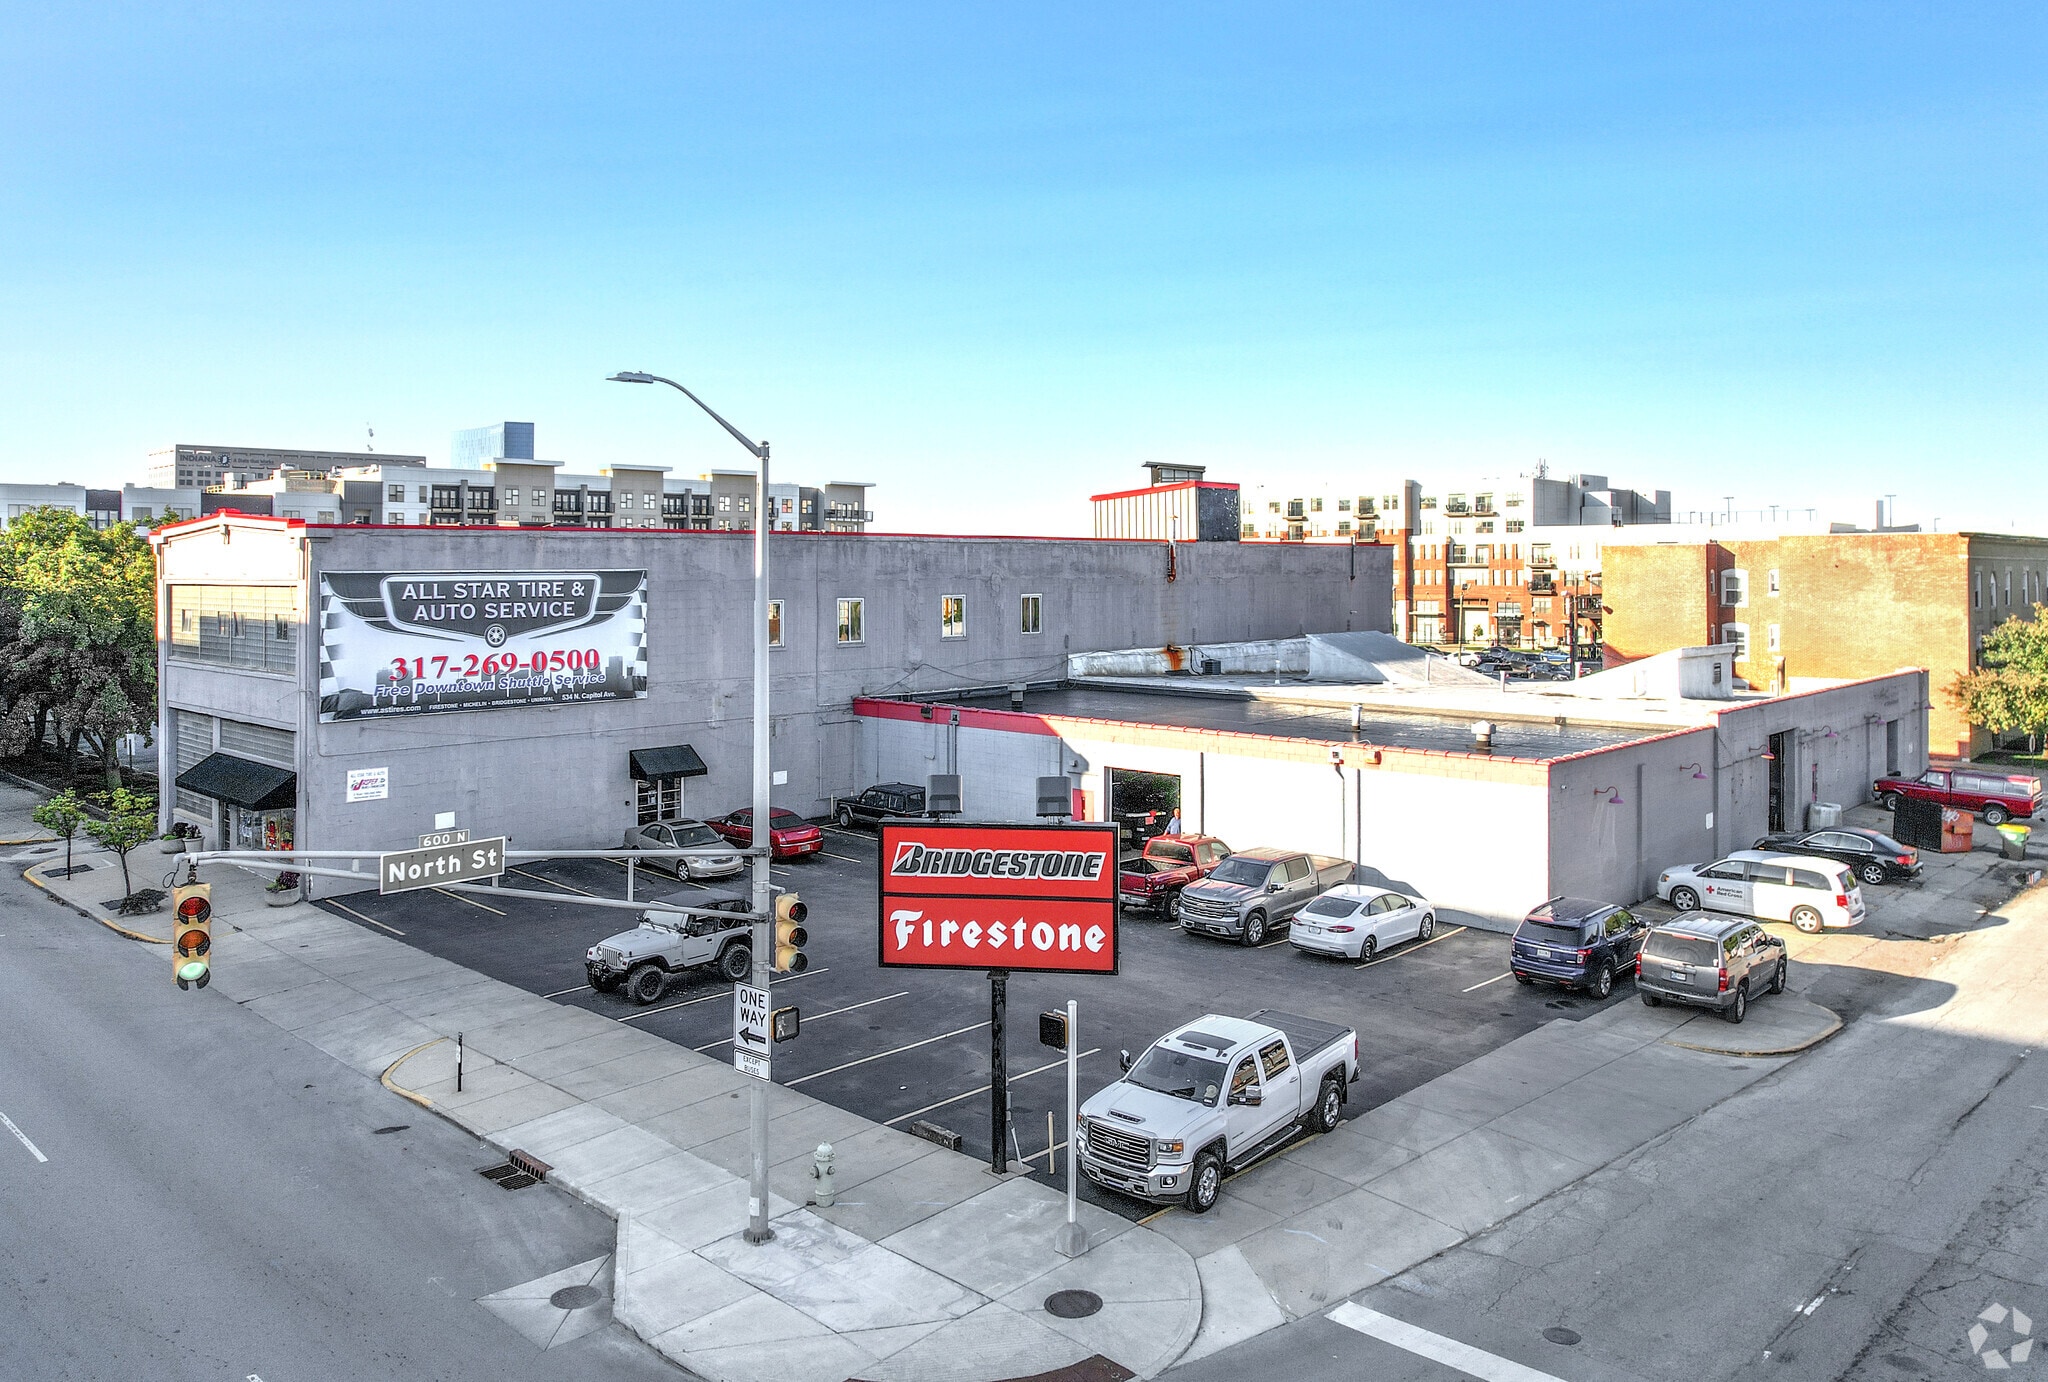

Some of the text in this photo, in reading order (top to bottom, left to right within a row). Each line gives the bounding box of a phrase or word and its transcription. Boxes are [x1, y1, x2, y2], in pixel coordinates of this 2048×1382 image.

[180, 454, 217, 463] INDIANA
[401, 580, 586, 600] ALL STAR TIRE &
[413, 601, 576, 621] AUTO SERVICE
[388, 648, 601, 682] 317-269-0500
[373, 674, 606, 697] Free Downtown Shuttle Service
[581, 691, 603, 700] Capitol
[360, 704, 422, 715] www.astires.com
[428, 702, 459, 710] FIRESTONE
[424, 832, 466, 847] 600 N
[389, 848, 497, 882] North St
[891, 843, 1106, 880] BRIDGESTONE
[889, 909, 1107, 953] Firestone
[740, 988, 766, 1010] ONE
[740, 1006, 766, 1028] WAY
[743, 1056, 760, 1066] EXCEPT
[744, 1064, 760, 1076] BUSES
